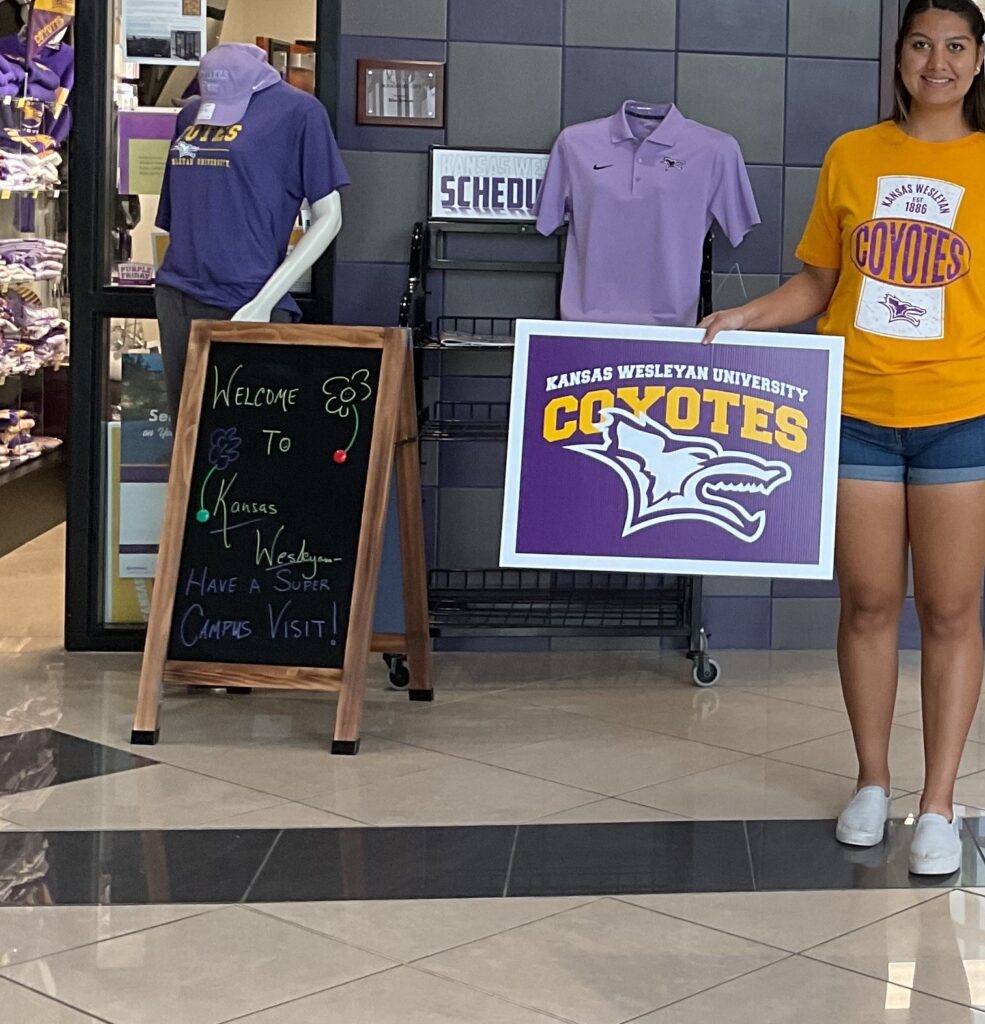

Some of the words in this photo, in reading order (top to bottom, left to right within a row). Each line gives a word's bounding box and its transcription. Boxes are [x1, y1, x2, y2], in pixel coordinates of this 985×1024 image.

[440, 154, 510, 176] KANSAS
[441, 175, 542, 209] SCHEDU
[881, 184, 913, 208] KANSAS
[915, 184, 951, 215] WESLEYAN
[905, 202, 928, 215] 1886
[855, 221, 964, 284] COYOTES
[212, 364, 300, 413] WELCOME
[545, 366, 613, 392] KANSAS
[617, 363, 709, 381] WESLEYAN
[712, 367, 809, 402] UNIVERSITY
[148, 409, 171, 423] Se
[542, 386, 808, 454] COYOTES
[213, 472, 278, 548] Kansas
